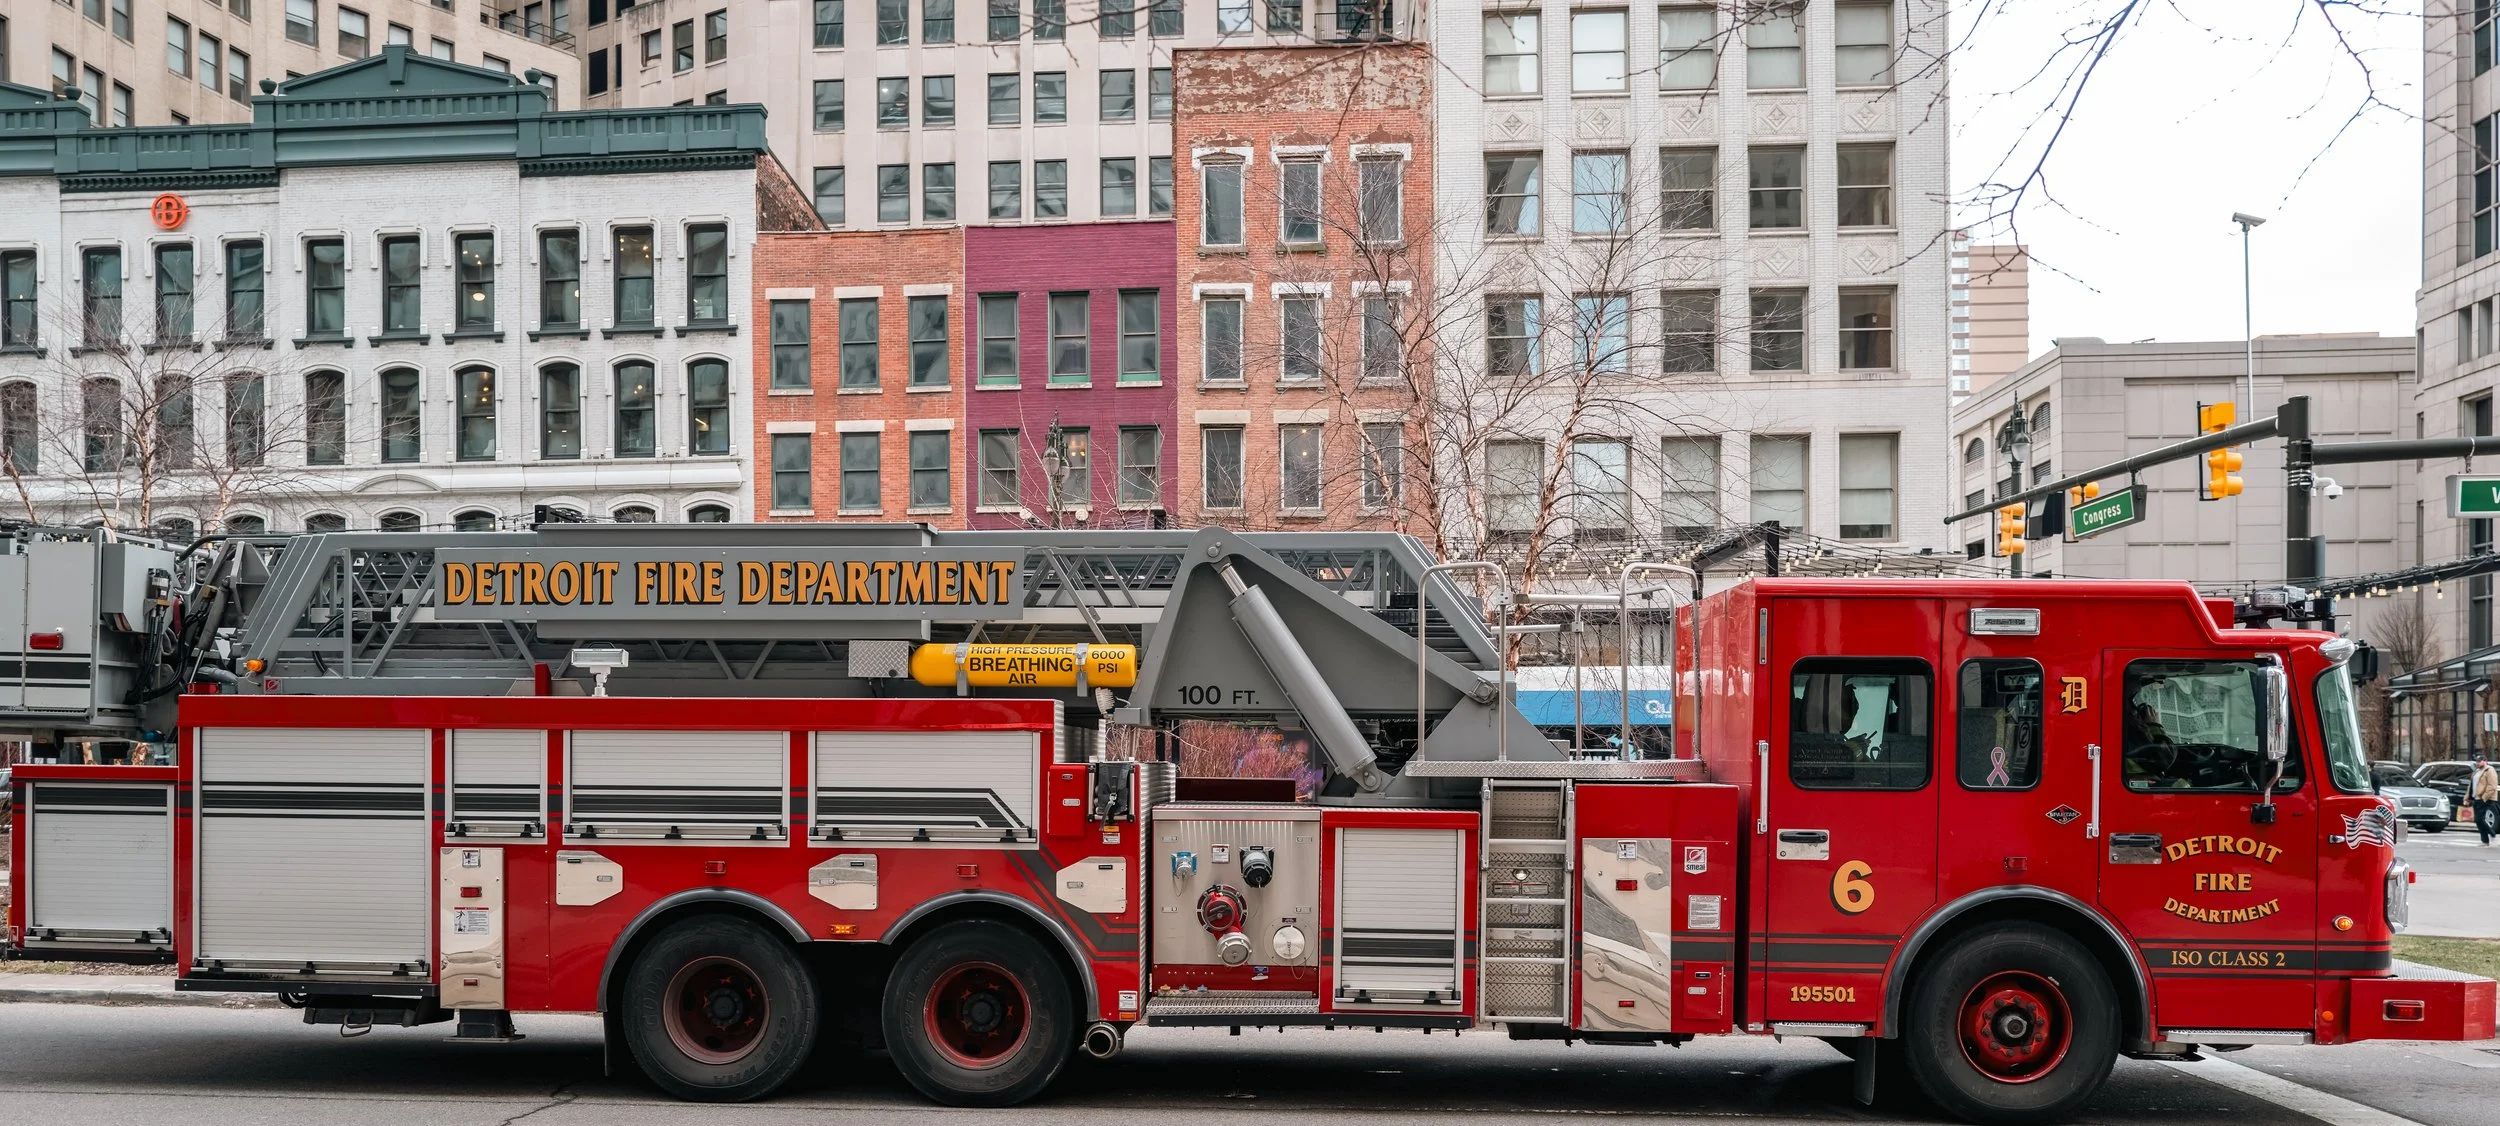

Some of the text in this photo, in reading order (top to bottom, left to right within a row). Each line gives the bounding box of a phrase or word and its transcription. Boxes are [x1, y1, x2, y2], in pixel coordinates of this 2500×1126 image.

[2083, 502, 2122, 525] Congress
[443, 560, 1017, 607] DETROIT FIRE DEPARTMENT
[970, 646, 1074, 655] HIGH PRESSURE
[1091, 650, 1126, 660] 6000
[969, 657, 1073, 672] BREATHING
[1097, 663, 1119, 674] PSI
[1008, 673, 1038, 685] AIR
[1178, 685, 1261, 705] 100 FT.
[2164, 835, 2283, 865] DETROIT
[1829, 859, 1875, 916] 6
[2194, 873, 2253, 892] FIRE
[2162, 897, 2281, 925] DEPARTMENT
[2171, 950, 2286, 967] ISO CLASS 2
[1790, 986, 1856, 1003] 195501
